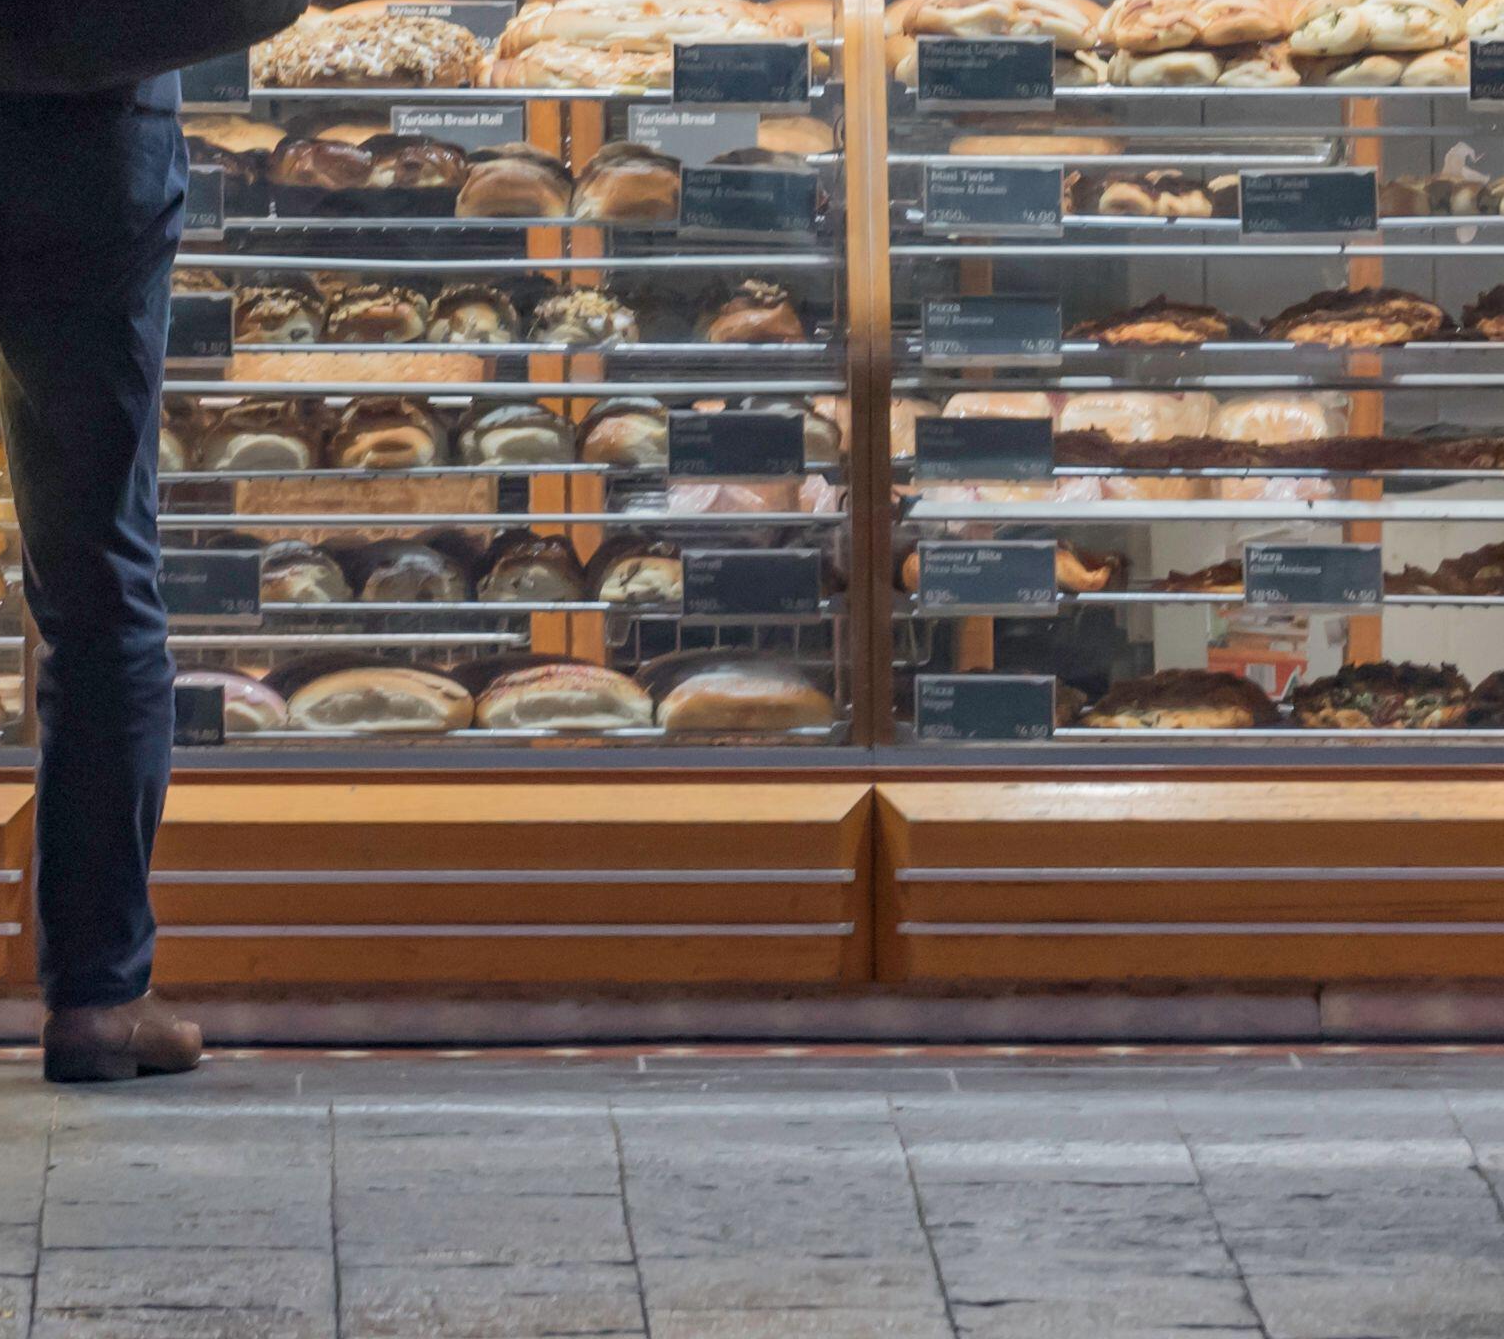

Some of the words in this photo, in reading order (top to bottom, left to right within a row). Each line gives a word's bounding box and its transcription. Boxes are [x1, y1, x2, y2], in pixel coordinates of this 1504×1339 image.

[429, 6, 451, 17] Roll
[399, 113, 443, 126] Turkish
[444, 114, 479, 126] Bread
[480, 113, 504, 125] Roll
[636, 113, 680, 125] Turkish
[681, 114, 715, 125] Bread
[931, 171, 959, 182] Mini
[961, 171, 995, 182] Twist
[928, 303, 960, 314] Pizza
[925, 551, 975, 564] Savoury
[1250, 552, 1283, 563] Pizza
